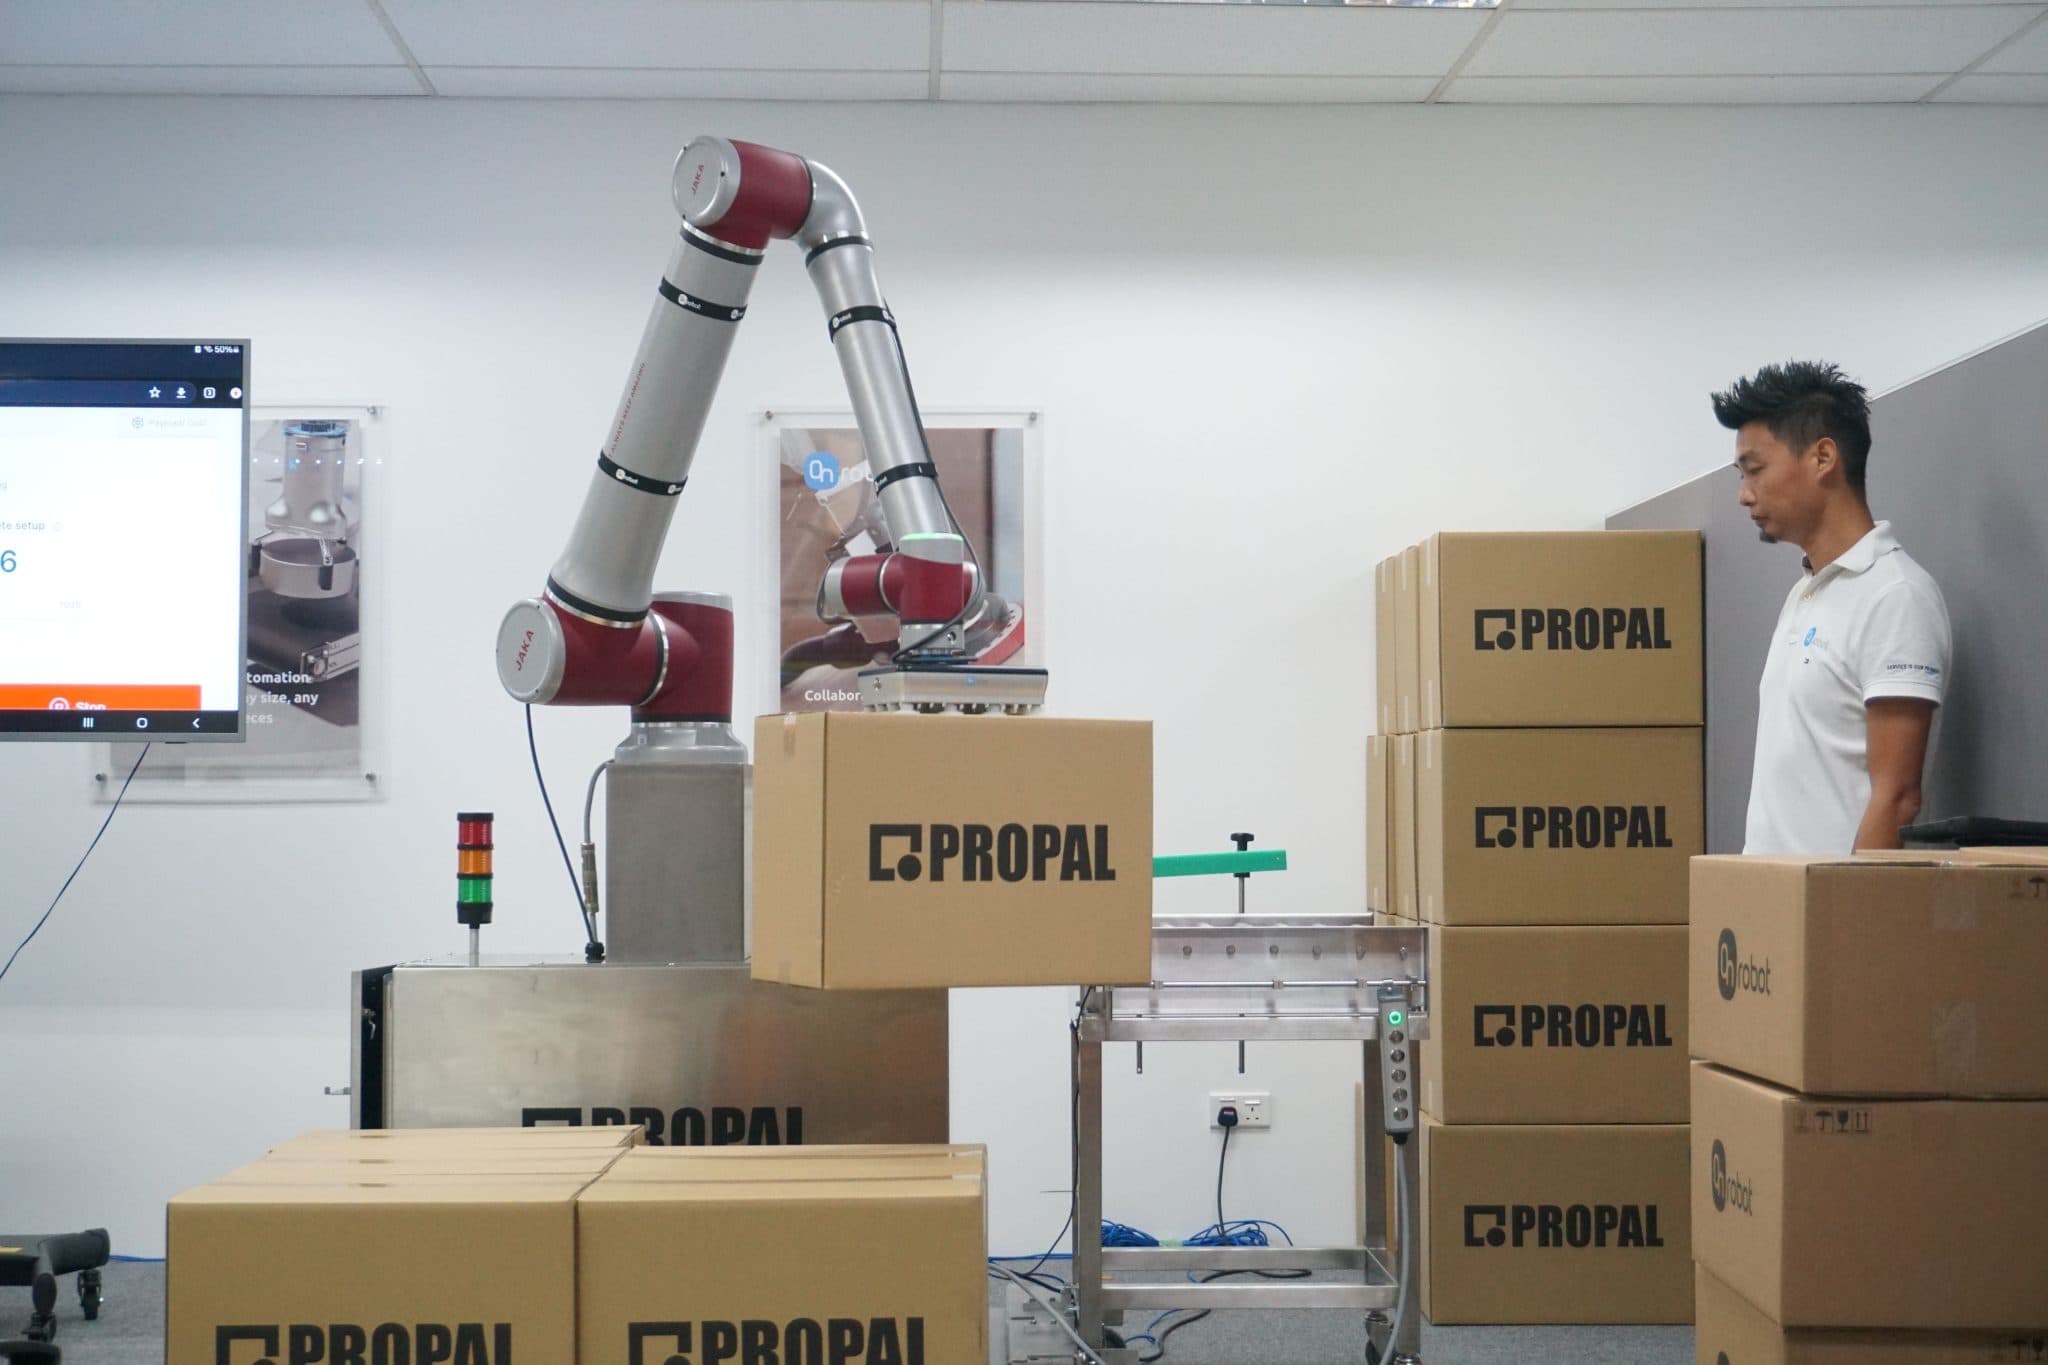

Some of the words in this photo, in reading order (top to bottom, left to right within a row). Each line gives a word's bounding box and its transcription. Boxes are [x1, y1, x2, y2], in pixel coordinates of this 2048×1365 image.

[691, 164, 705, 195] JAKA
[15, 521, 46, 532] setup
[0, 550, 17, 573] 6
[1522, 607, 1672, 650] PROPAL
[515, 630, 534, 671] JAKA
[260, 691, 292, 705] size,
[294, 694, 319, 706] any
[804, 689, 863, 702] Collabor
[1523, 805, 1673, 849] PROPAL
[930, 823, 1116, 883] PROPAL
[1521, 1003, 1673, 1049] PROPAL
[1511, 1200, 1665, 1249] PROPAL
